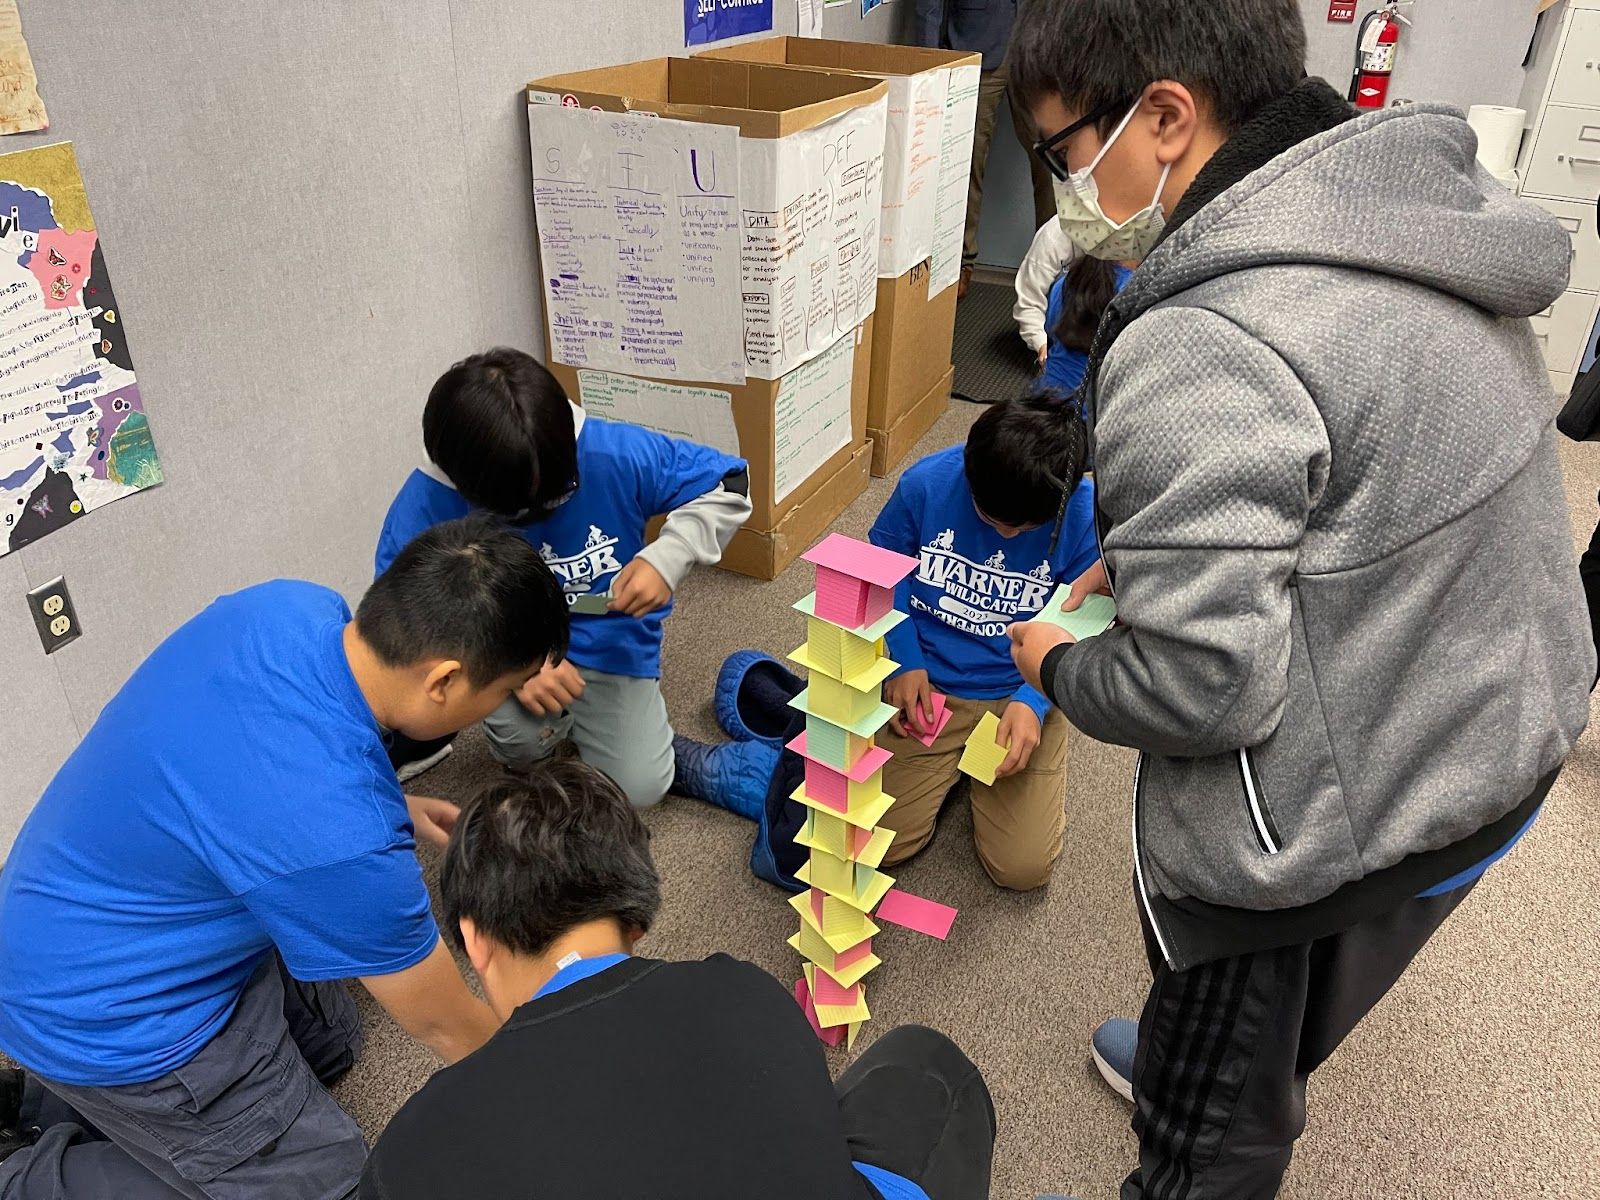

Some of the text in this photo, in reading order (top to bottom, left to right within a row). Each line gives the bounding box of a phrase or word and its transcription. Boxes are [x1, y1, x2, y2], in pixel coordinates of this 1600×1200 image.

[690, 149, 716, 193] U
[823, 130, 855, 176] DEF
[749, 216, 769, 227] DATA
[916, 550, 1050, 610] WARNER
[945, 581, 1018, 614] WILDCATS
